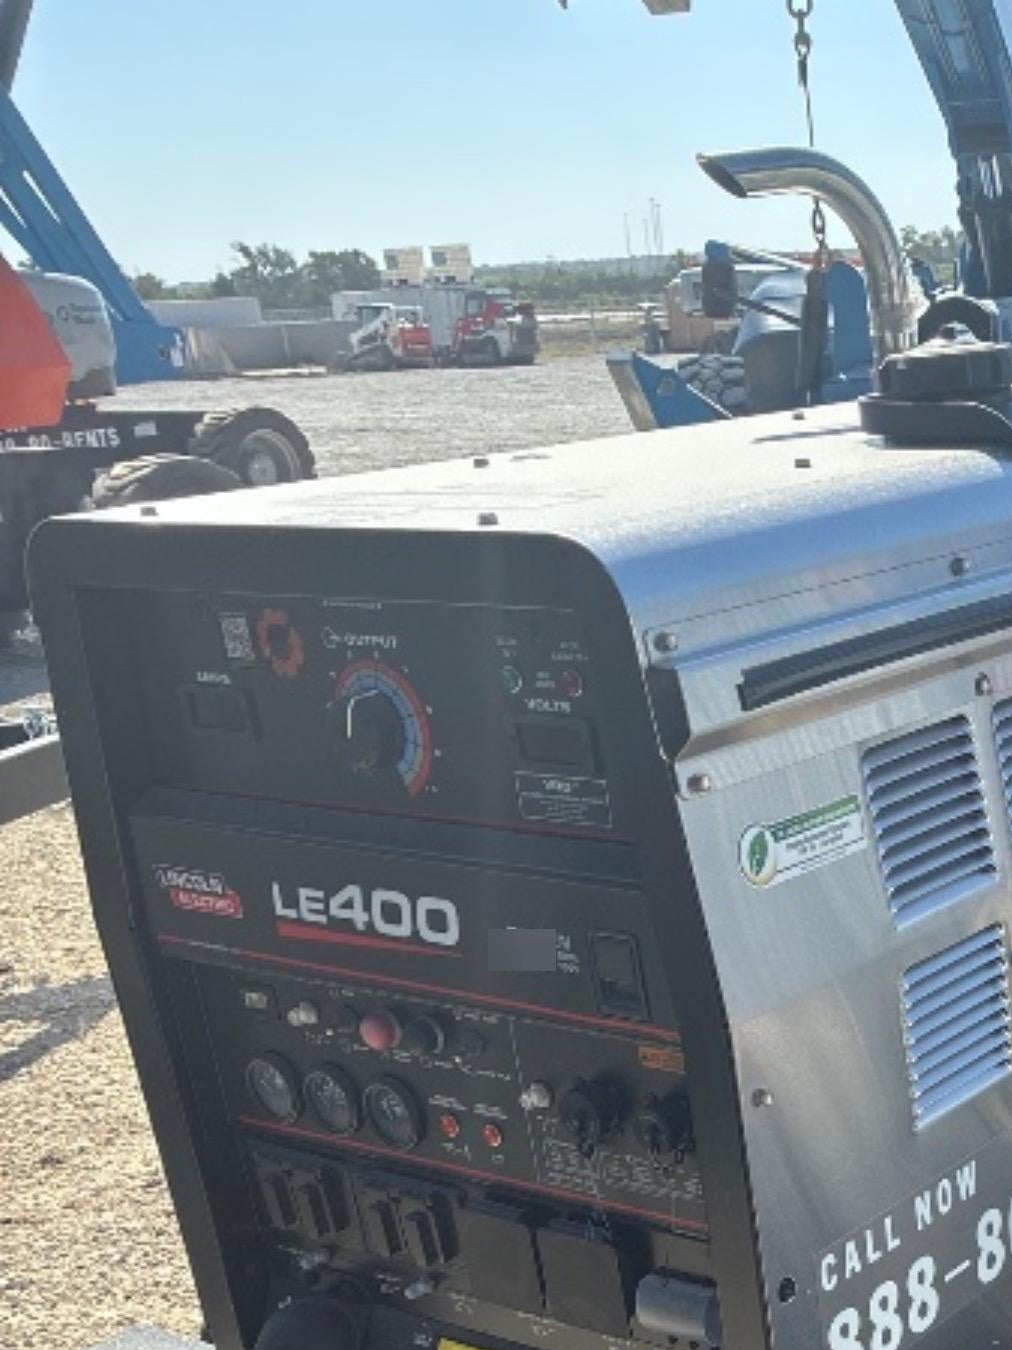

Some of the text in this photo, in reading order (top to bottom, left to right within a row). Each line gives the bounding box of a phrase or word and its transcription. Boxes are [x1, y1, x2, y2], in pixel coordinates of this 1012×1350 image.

[271, 881, 460, 946] LE400
[819, 1159, 978, 1292] CALL NOW
